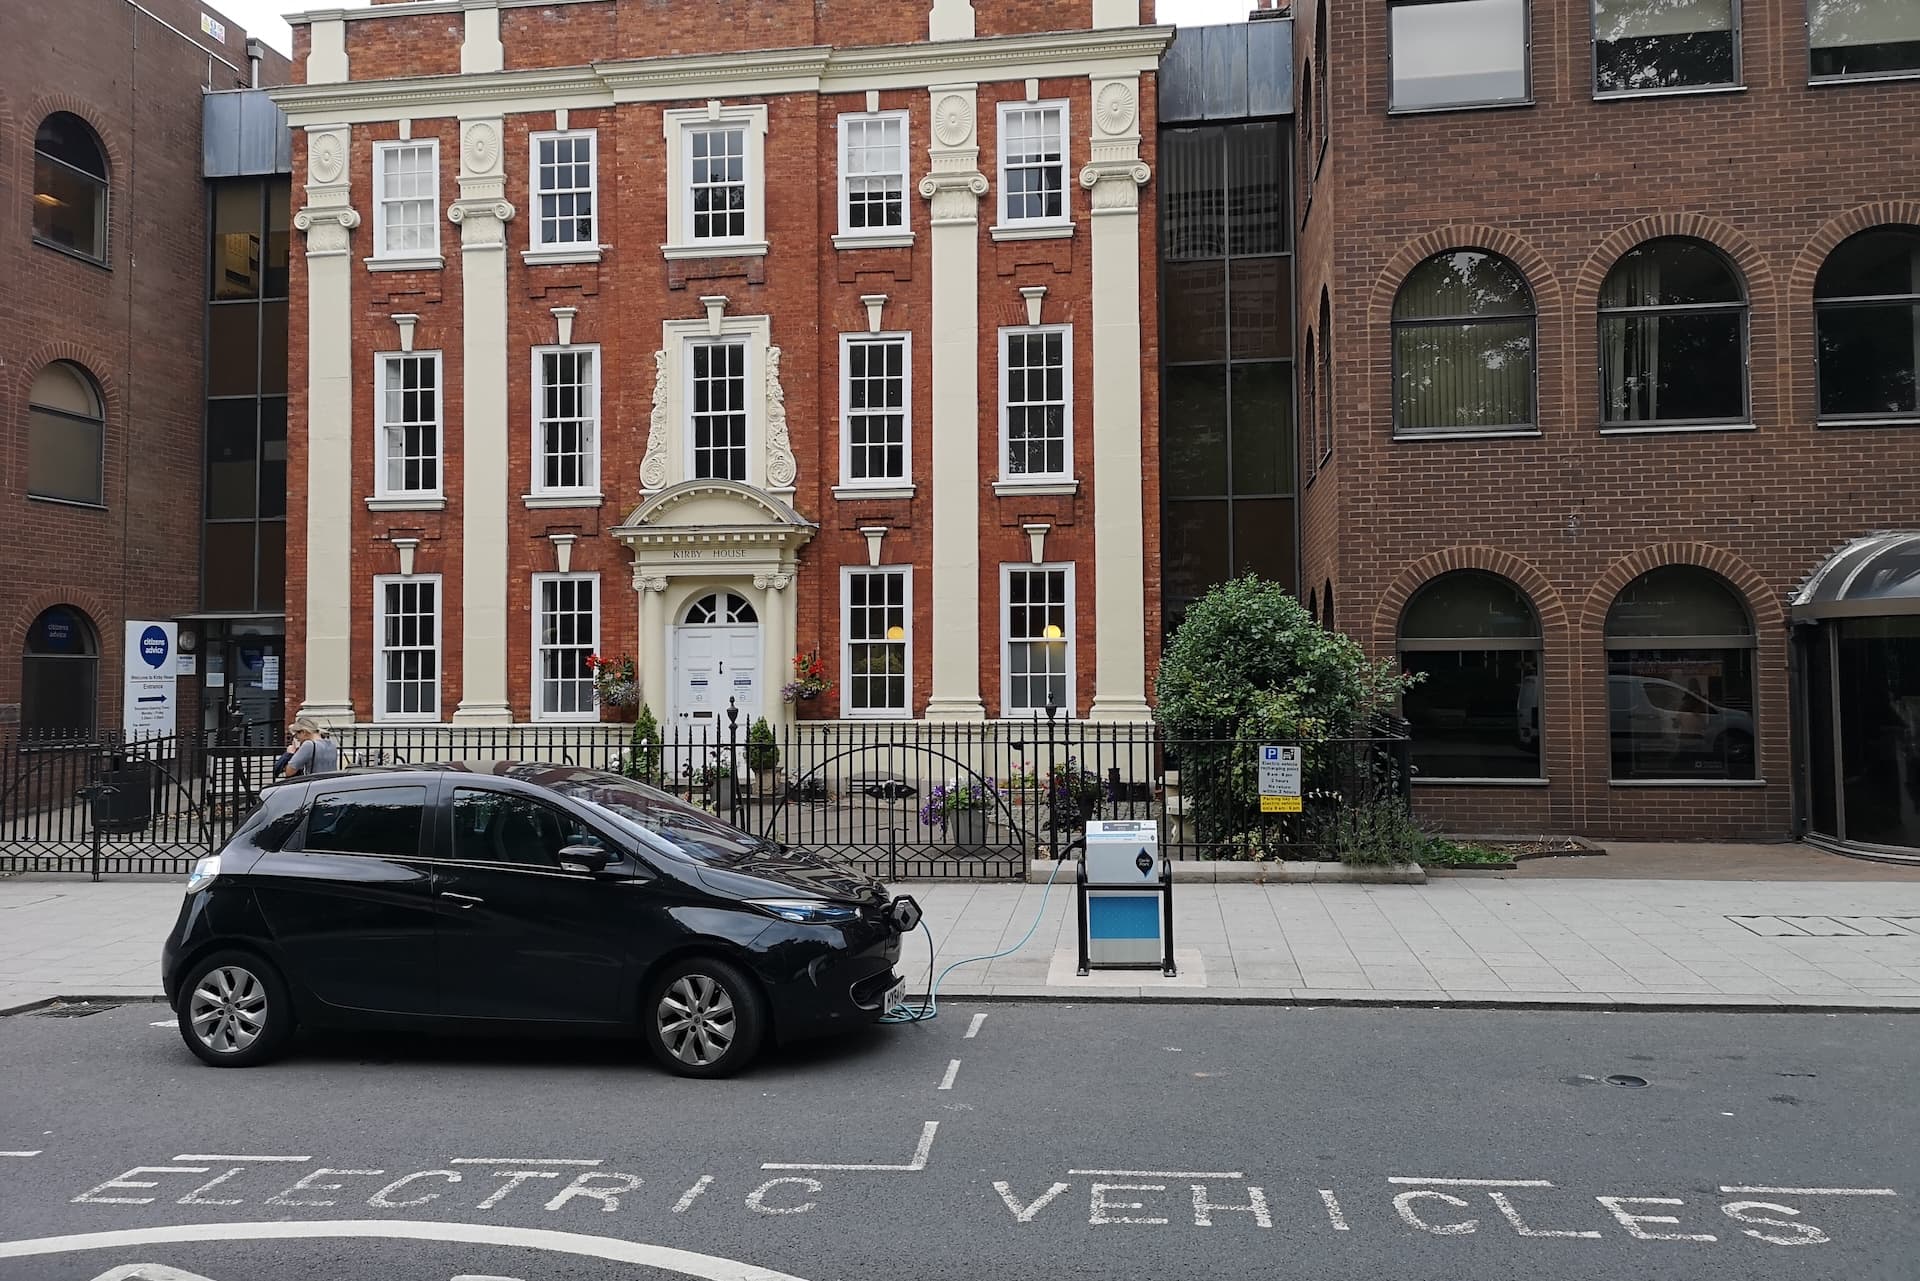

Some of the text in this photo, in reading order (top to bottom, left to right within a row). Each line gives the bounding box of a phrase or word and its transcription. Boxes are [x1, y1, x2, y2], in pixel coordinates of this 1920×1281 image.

[673, 549, 747, 559] KIRBY HOUSE
[144, 638, 165, 646] citizens
[145, 646, 164, 654] advice
[1268, 749, 1276, 758] P
[70, 1166, 824, 1215] ELECTRIC
[992, 1179, 1830, 1246] VEHICLES
